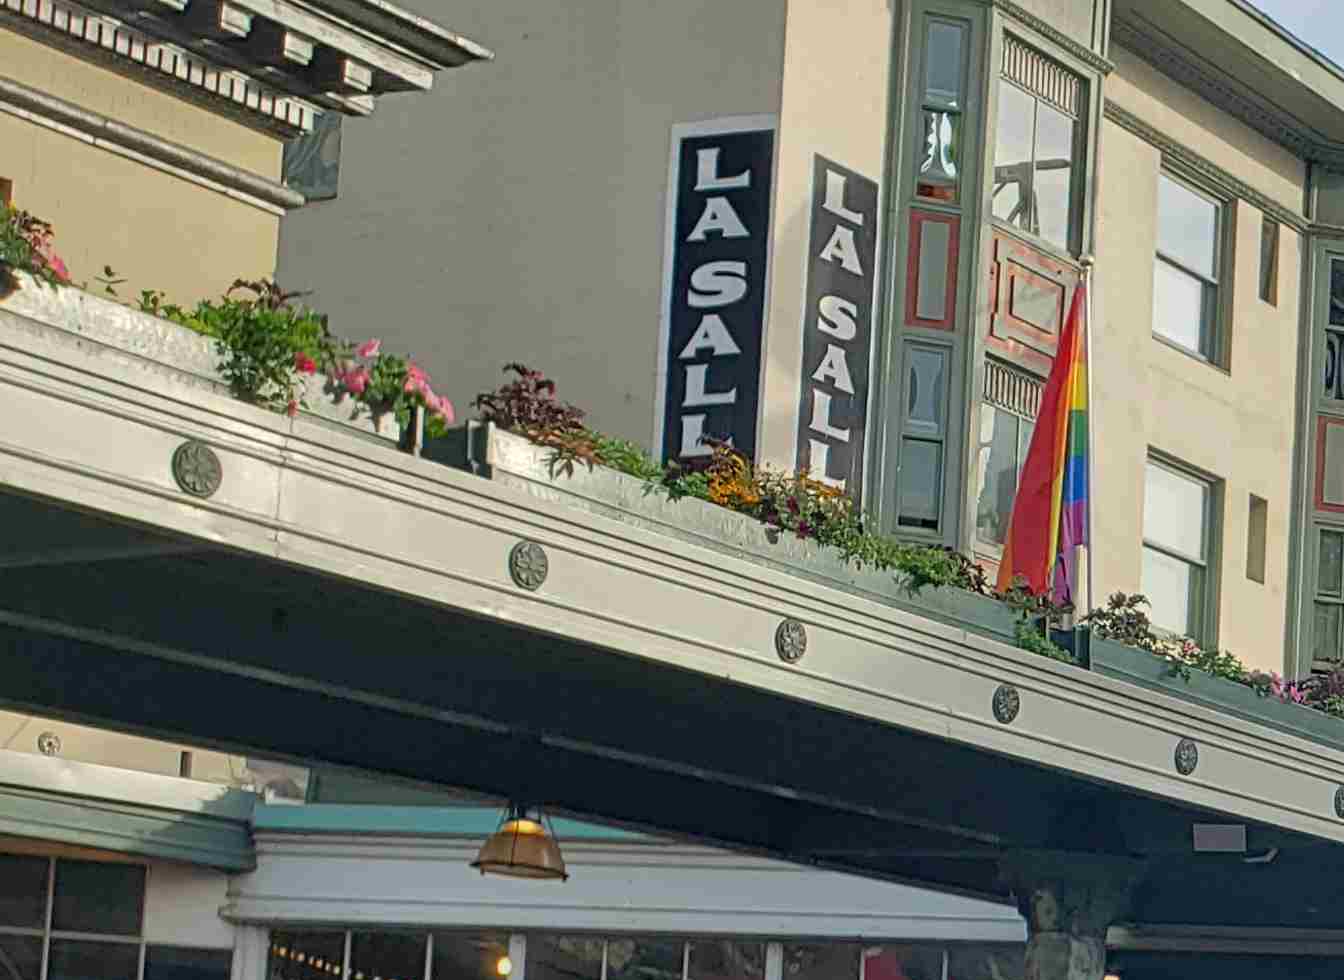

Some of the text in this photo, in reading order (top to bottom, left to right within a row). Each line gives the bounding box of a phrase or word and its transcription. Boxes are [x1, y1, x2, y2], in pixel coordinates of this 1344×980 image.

[679, 147, 750, 459] LA SALL
[808, 168, 864, 490] LA SALL
